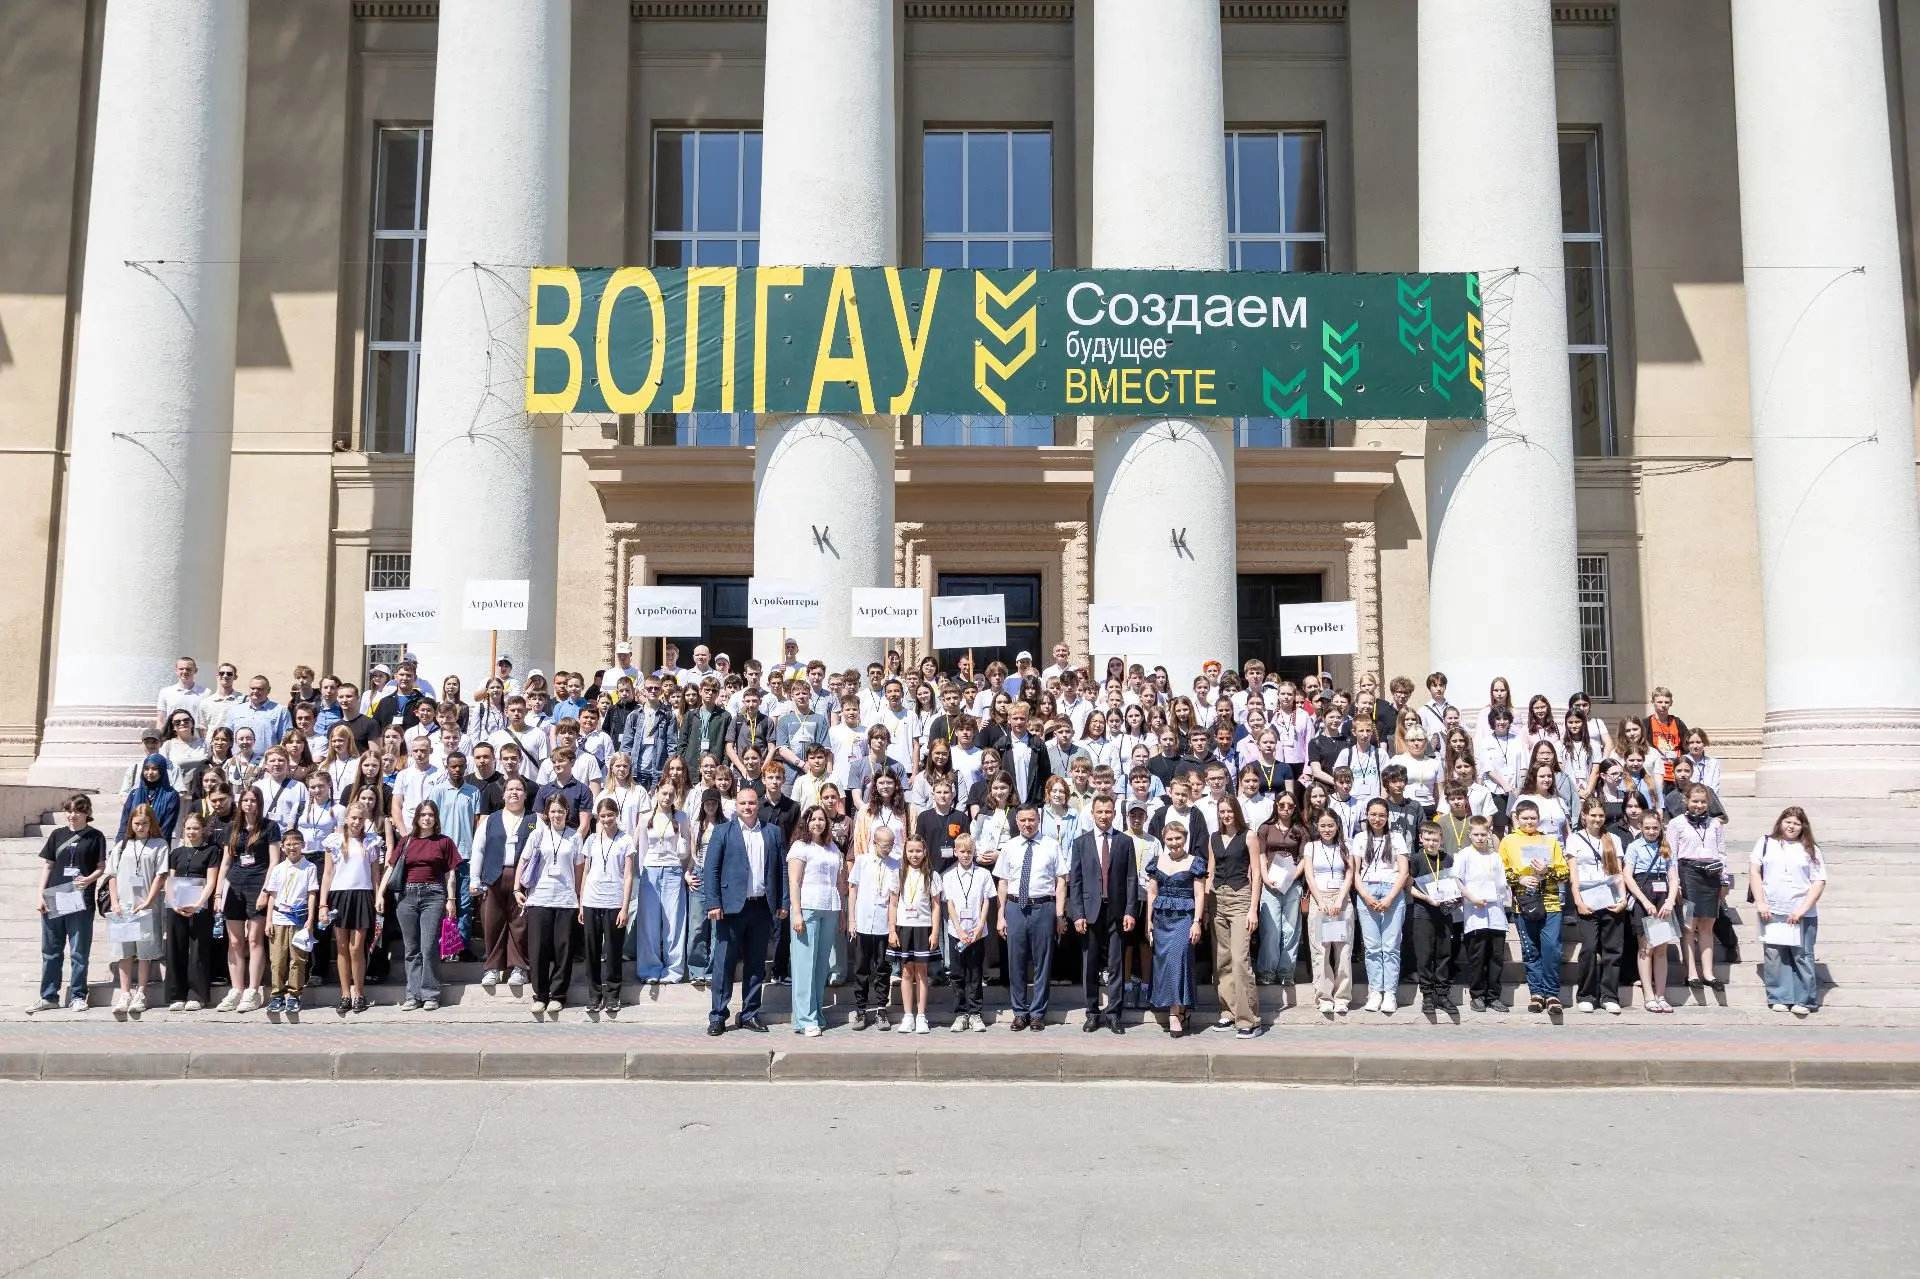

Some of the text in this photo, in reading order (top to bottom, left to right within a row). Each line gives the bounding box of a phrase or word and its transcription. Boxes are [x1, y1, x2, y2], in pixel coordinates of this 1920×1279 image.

[1066, 282, 1307, 334] Создаем
[526, 266, 943, 415] ВОЛГАУ
[1066, 330, 1167, 364] будущее
[1065, 368, 1217, 405] ВМЕСТЕ
[469, 599, 524, 610] АгроМетео
[751, 596, 819, 608] АгроКоптеры
[372, 609, 436, 621] АгроКосмос
[634, 606, 697, 618] АгроРоботы
[857, 606, 919, 618] АгроСмарт
[937, 614, 1000, 628] ДоброПчёл
[1101, 623, 1153, 635] АгроБио
[1293, 623, 1346, 635] АгроВет
